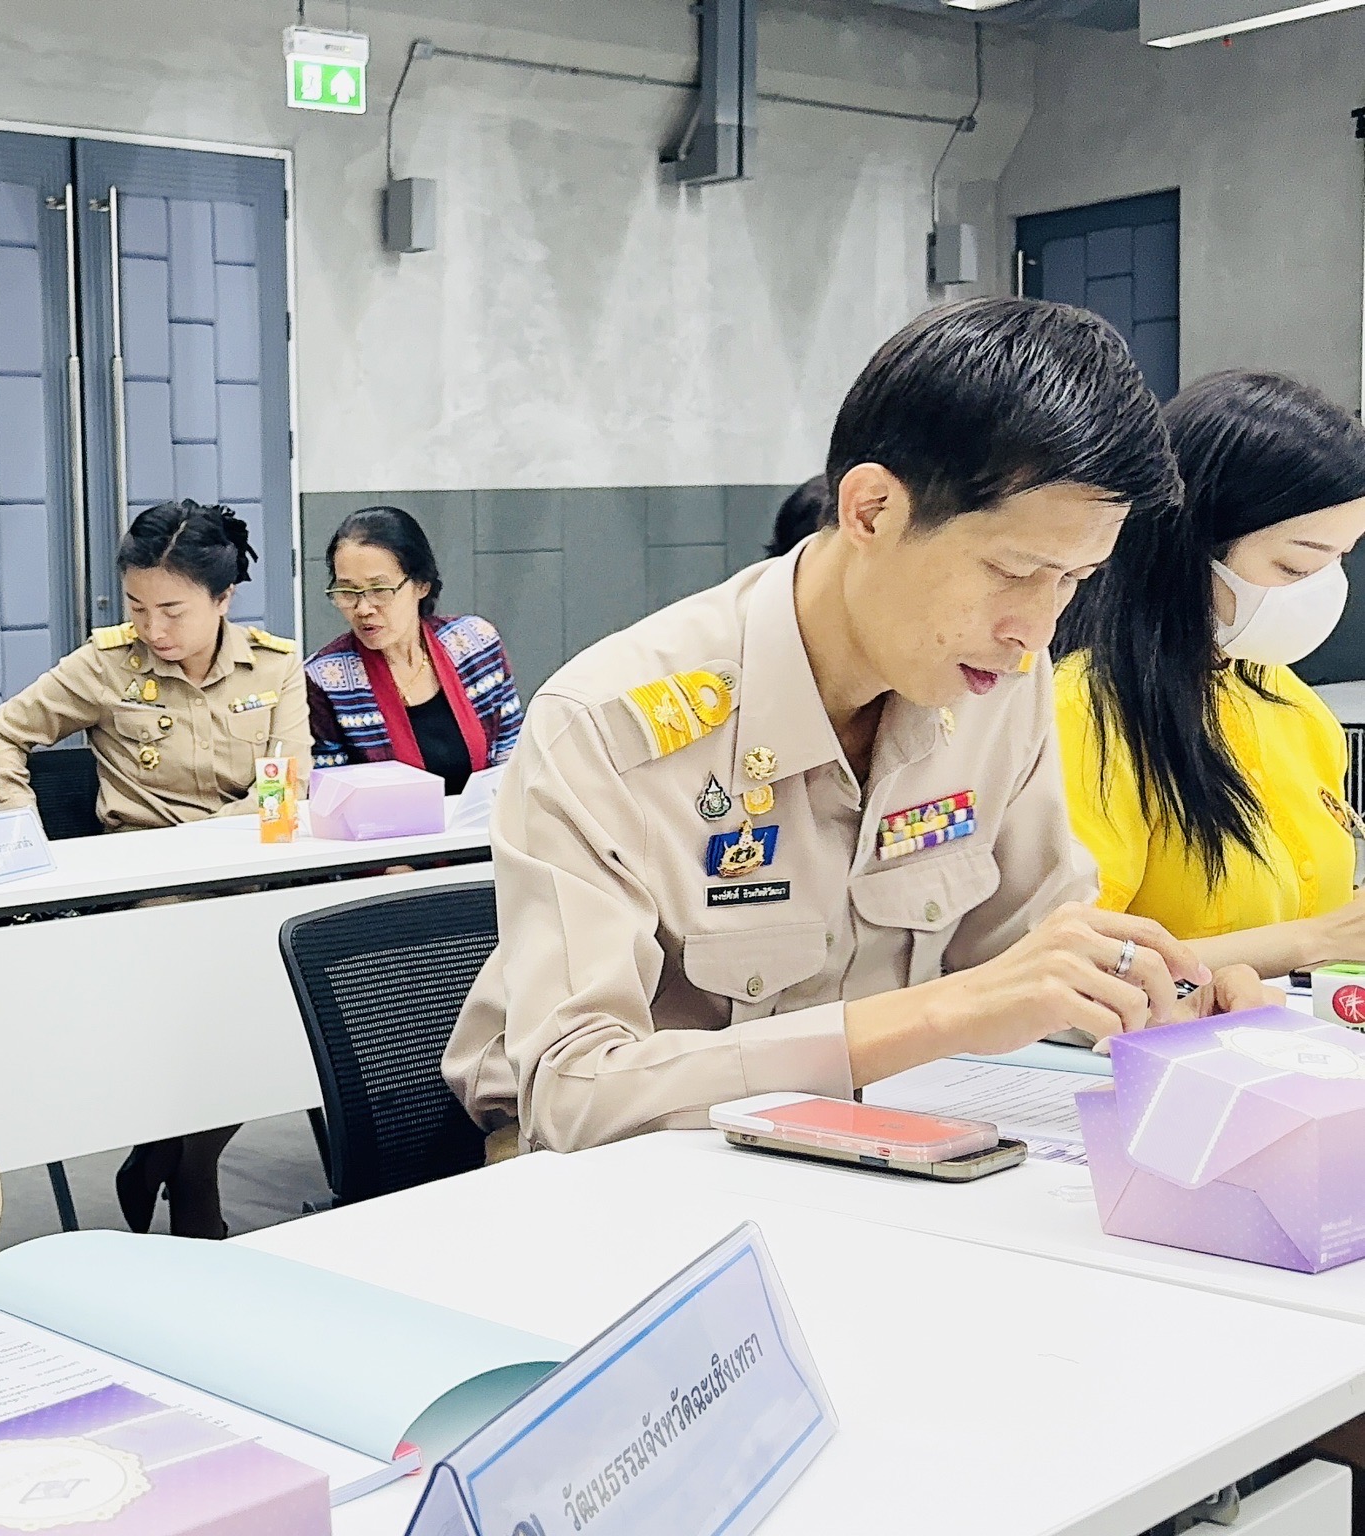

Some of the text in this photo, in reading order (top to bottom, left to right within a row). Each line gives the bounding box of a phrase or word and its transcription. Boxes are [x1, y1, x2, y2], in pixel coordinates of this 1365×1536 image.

[563, 1332, 765, 1533] วัฒนธรรมจังหวัดฉะเชิงเทรา
